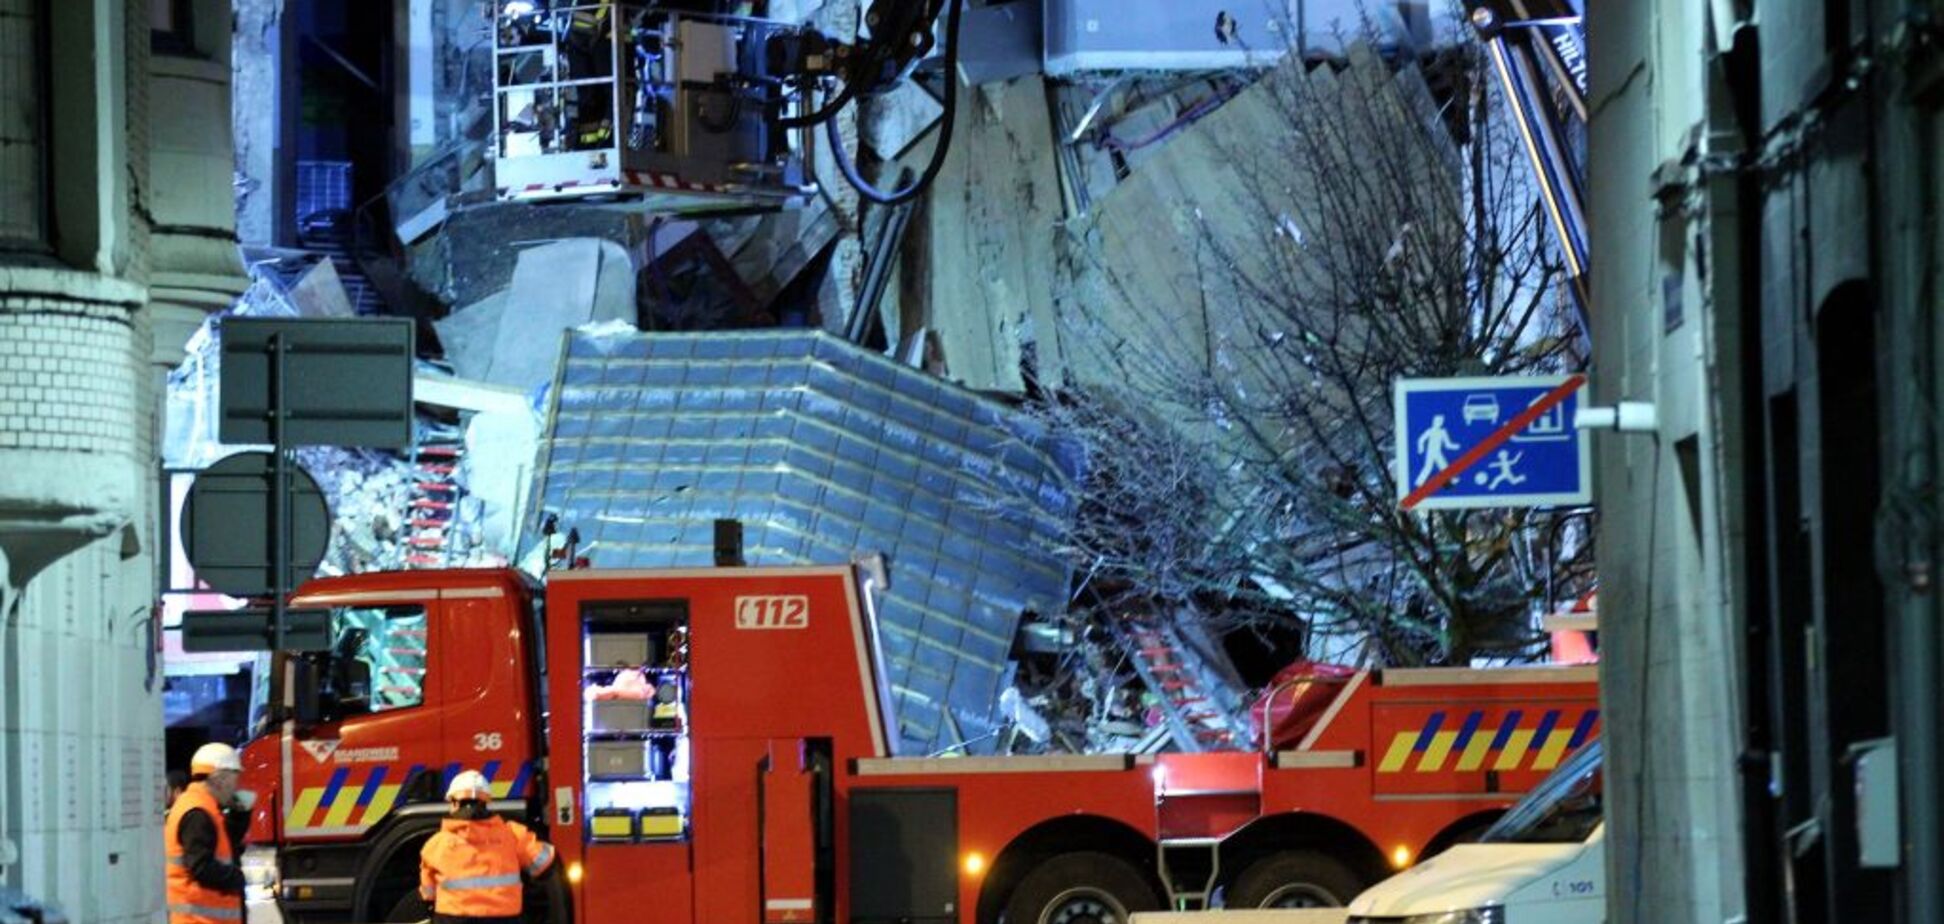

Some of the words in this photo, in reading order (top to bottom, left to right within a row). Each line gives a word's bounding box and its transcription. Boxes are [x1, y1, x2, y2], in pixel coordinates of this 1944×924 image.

[1552, 32, 1587, 96] HILTO
[754, 598, 804, 625] 112
[473, 732, 502, 751] 36
